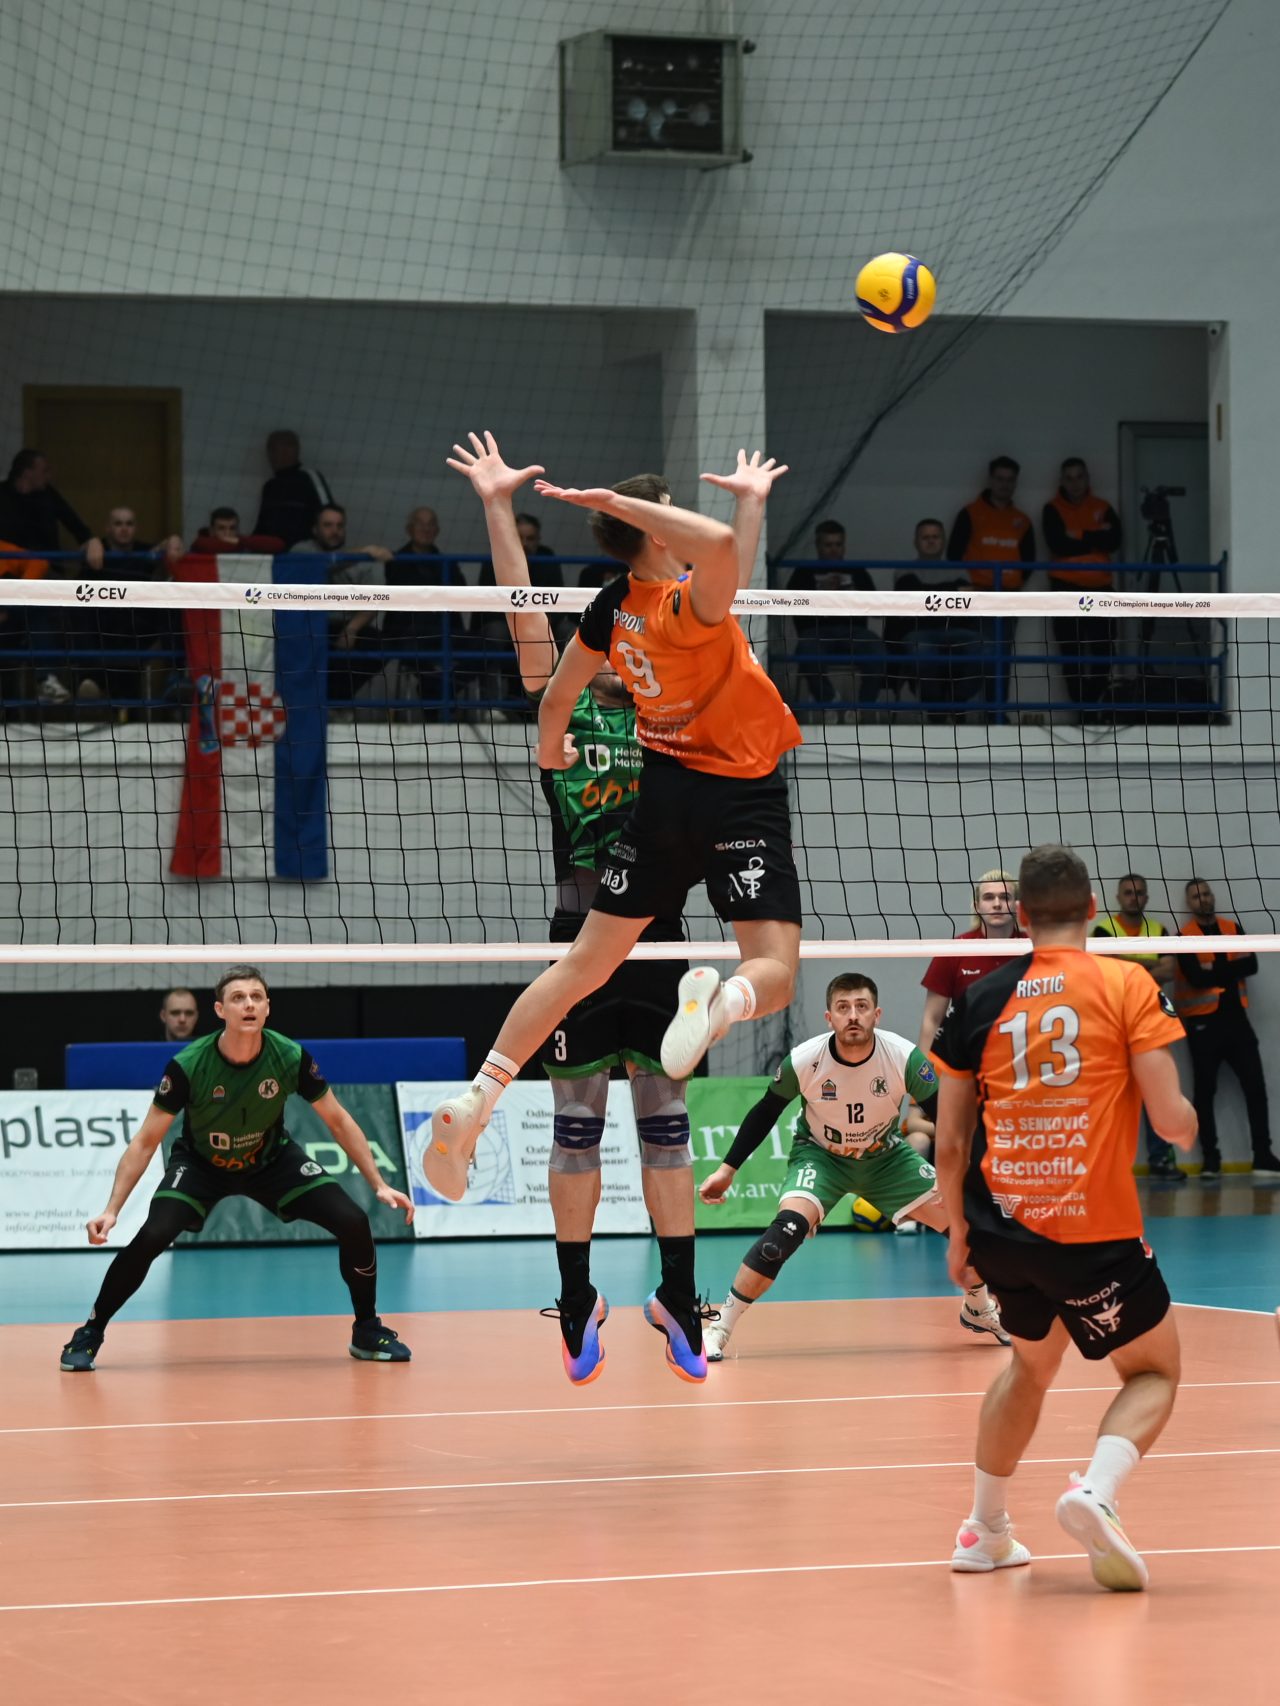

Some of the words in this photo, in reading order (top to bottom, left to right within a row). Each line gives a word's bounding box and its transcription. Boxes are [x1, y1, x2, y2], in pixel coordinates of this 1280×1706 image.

[98, 587, 127, 600] CEV
[267, 592, 282, 600] CEV
[284, 592, 322, 601] Champions
[324, 593, 348, 601] League
[350, 594, 371, 602] Volley
[532, 593, 559, 605] CEV
[746, 598, 770, 606] League
[772, 598, 792, 607] Volley
[945, 598, 972, 609] CEV
[1114, 601, 1149, 609] Champions
[616, 640, 663, 698] 9
[1016, 972, 1065, 998] RISTIĆ
[554, 1030, 567, 1061] 3
[999, 1004, 1081, 1090] 13
[846, 1102, 864, 1124] 12
[994, 1119, 1015, 1132] AS
[1018, 1112, 1089, 1131] SENKOVIĆ
[991, 1156, 1074, 1176] tecnofil
[796, 1168, 817, 1189] 12
[1024, 1205, 1086, 1219] POSAVINA
